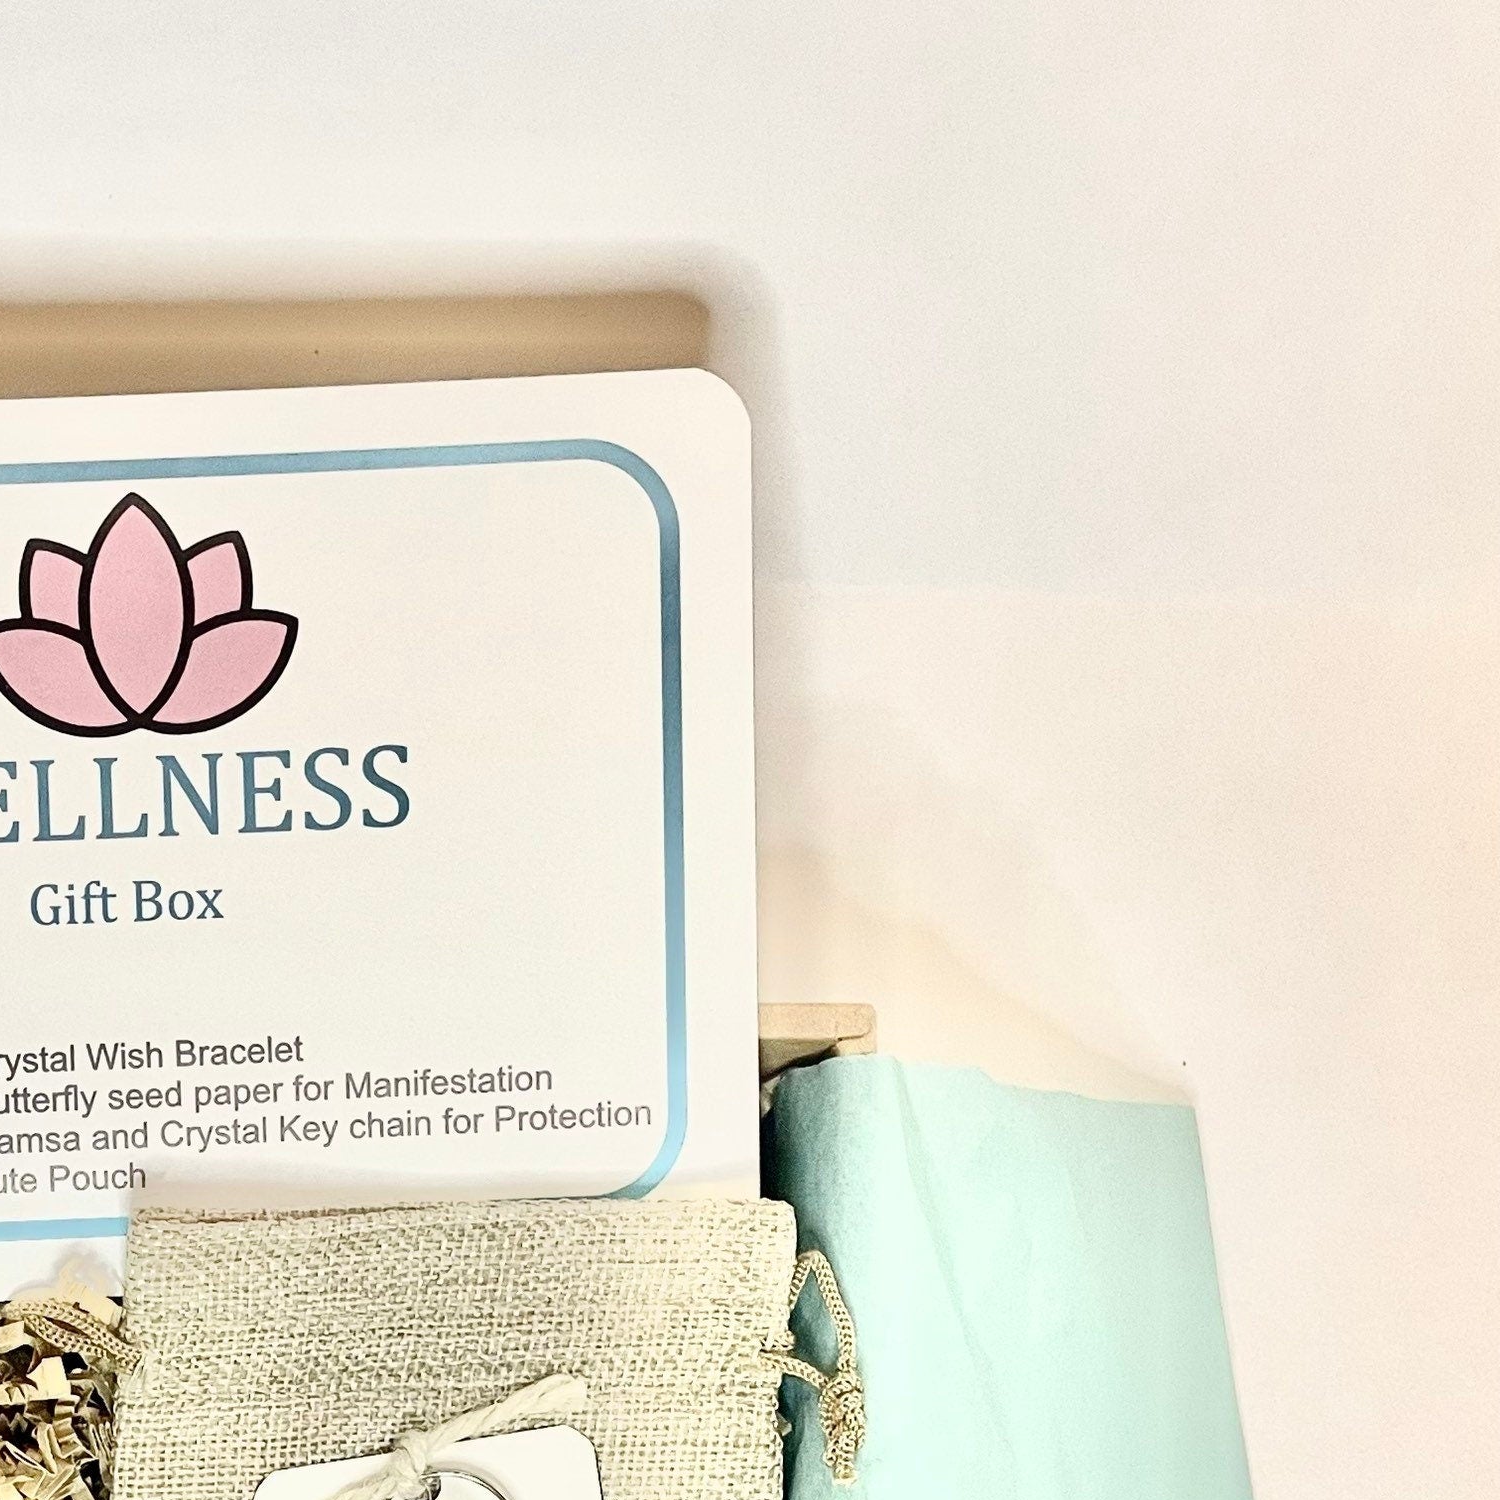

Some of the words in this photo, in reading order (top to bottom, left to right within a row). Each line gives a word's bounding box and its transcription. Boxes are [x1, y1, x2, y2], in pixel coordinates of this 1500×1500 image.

[30, 880, 118, 926] Gift
[132, 880, 224, 923] Box
[85, 1041, 164, 1071] Wish
[175, 1035, 304, 1067] Bracelet
[108, 1080, 182, 1111] seed
[194, 1082, 284, 1114] paper
[292, 1074, 334, 1102] for
[345, 1065, 552, 1100] Manifestation
[92, 1121, 148, 1151] and
[160, 1116, 267, 1153] Crystal
[280, 1114, 338, 1146] Key
[349, 1109, 431, 1139] chain
[441, 1107, 485, 1135] for
[495, 1100, 651, 1132] Protection
[49, 1161, 146, 1192] Pouch
